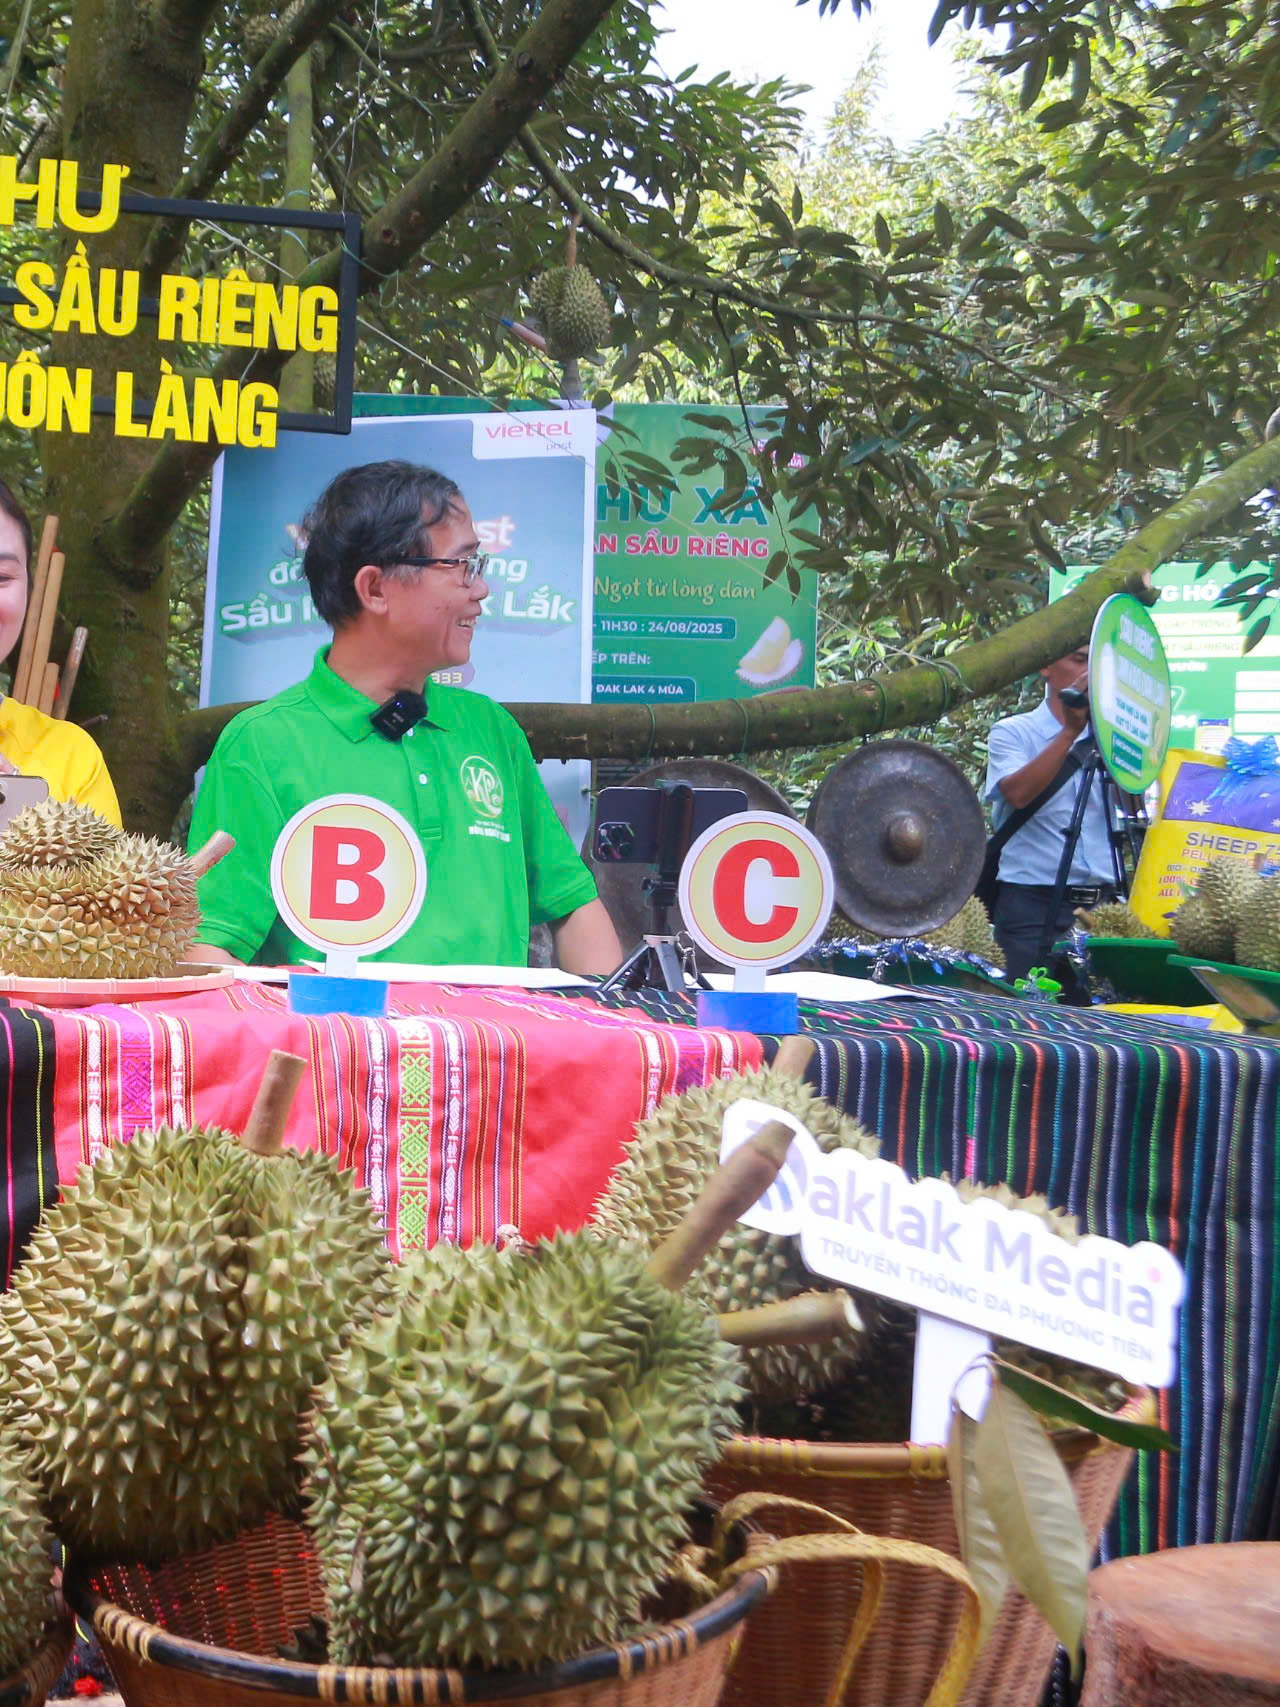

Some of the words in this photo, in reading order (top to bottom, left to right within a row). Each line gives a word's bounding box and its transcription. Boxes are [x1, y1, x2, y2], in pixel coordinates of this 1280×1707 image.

[13, 240, 140, 336] SẦU
[158, 268, 338, 352] RIÊNG
[114, 360, 279, 448] LÀNG
[485, 421, 572, 439] viettel
[503, 584, 575, 623] Lắk
[671, 578, 714, 606] lòng
[720, 580, 756, 599] dân
[601, 619, 638, 632] 11H30
[648, 620, 723, 635] 24/08/2025
[611, 650, 651, 665] TRÊN:
[623, 685, 645, 695] LAK
[648, 685, 656, 694] 4
[1185, 831, 1258, 855] SHEEP
[309, 825, 387, 922] B
[713, 839, 801, 943] C
[984, 1220, 1157, 1329] Media
